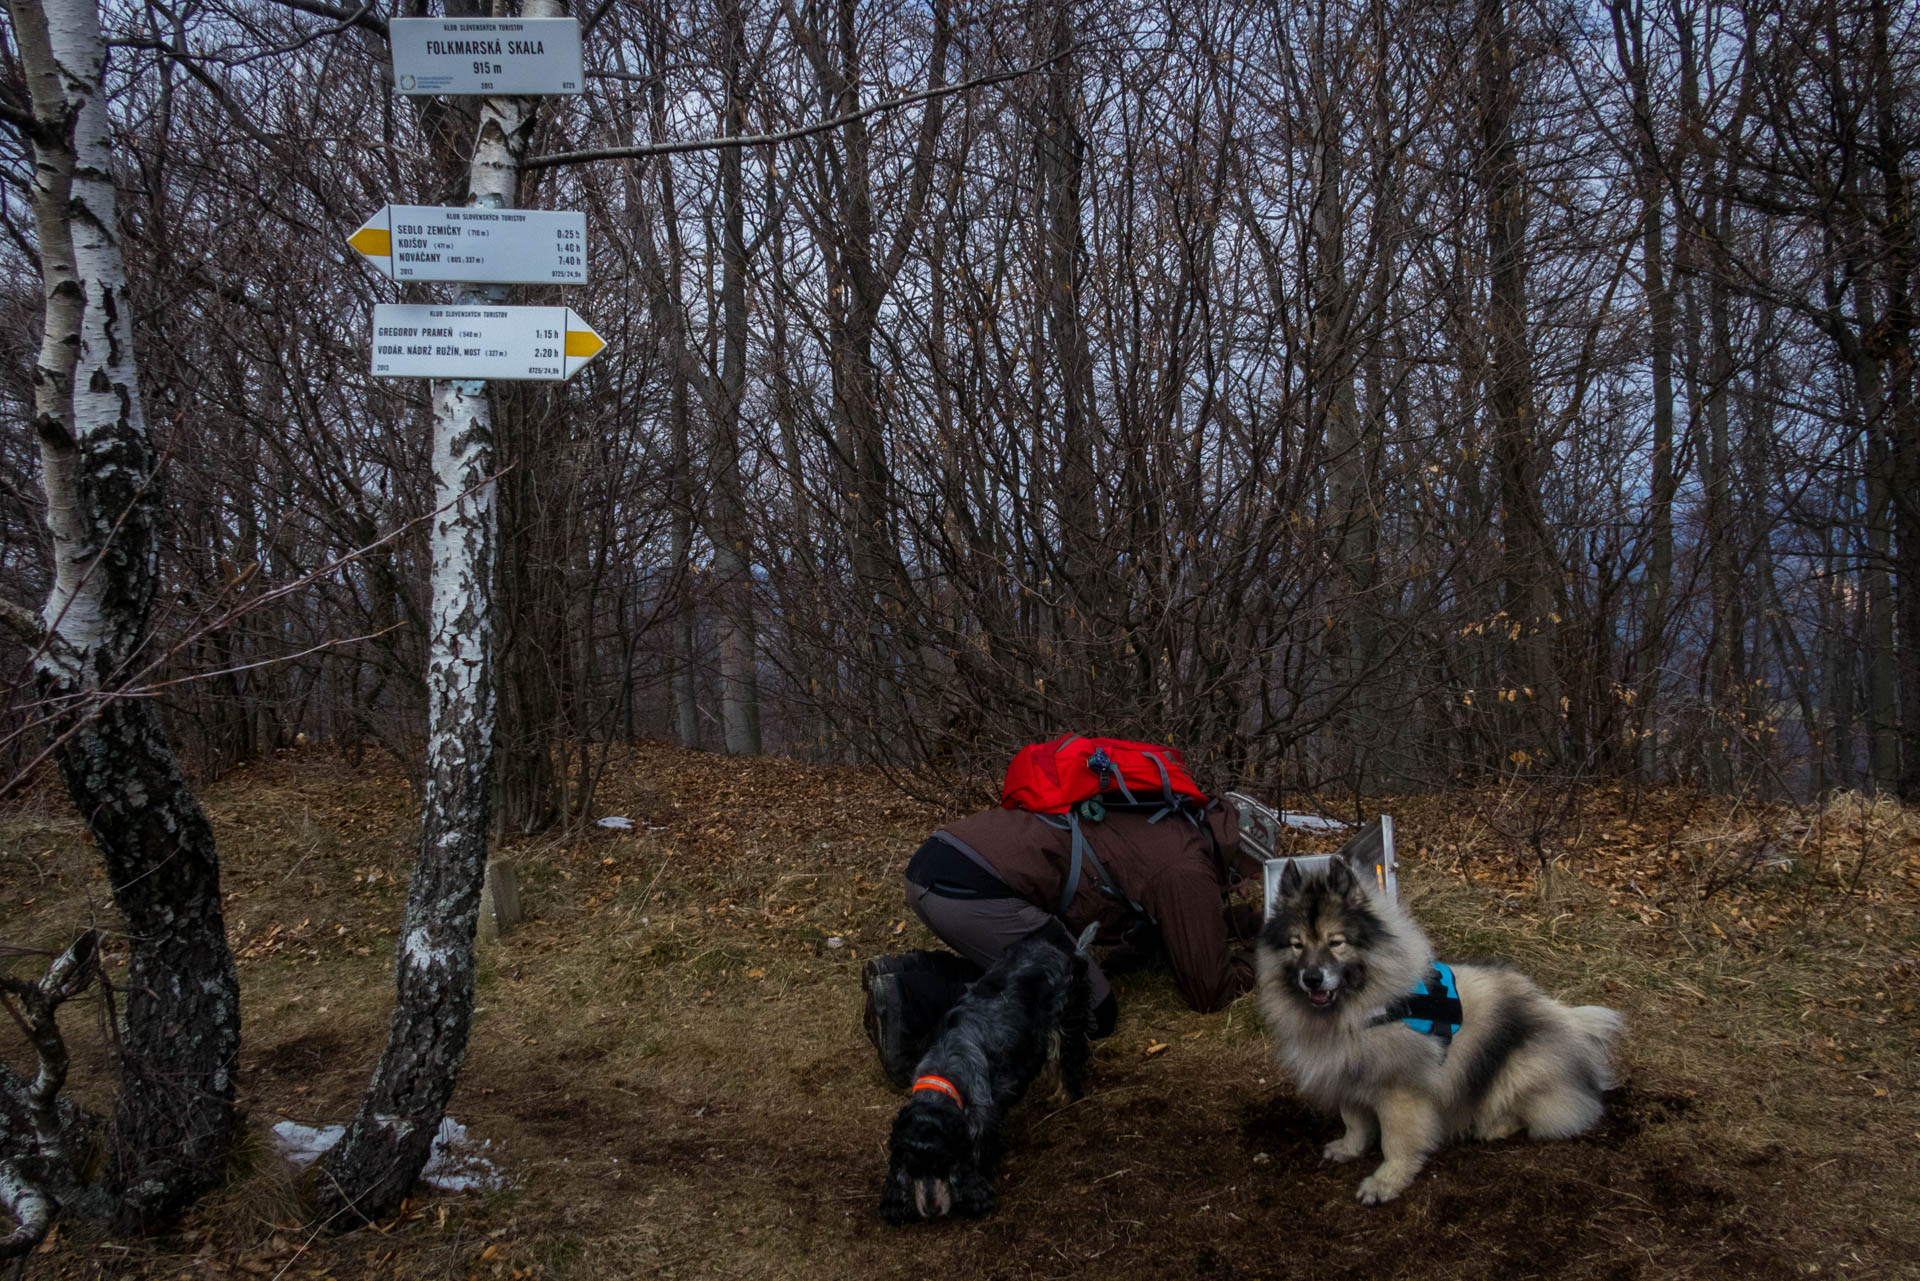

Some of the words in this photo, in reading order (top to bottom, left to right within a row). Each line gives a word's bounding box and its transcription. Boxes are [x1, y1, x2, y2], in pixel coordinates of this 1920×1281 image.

[498, 24, 524, 32] TURISTOV
[426, 38, 502, 54] FOLKMARSKÁ
[508, 40, 544, 54] SKALA
[473, 62, 490, 74] 915
[494, 64, 502, 74] m
[398, 224, 422, 234] SEDLO
[426, 224, 462, 236] ZEMIČKY
[556, 230, 574, 238] 0:25
[398, 238, 428, 248] KOJŠOV
[576, 244, 580, 252] h
[399, 252, 440, 262] NOVÁČANY
[558, 256, 574, 265] 7:40
[576, 256, 581, 265] h
[378, 328, 418, 336] GREGOROV
[422, 326, 453, 337] PRAMEŇ
[554, 330, 558, 338] h
[378, 344, 405, 354] VODÁR.
[407, 344, 432, 356] NÁDRŽ
[436, 344, 462, 356] RUŽÍN,
[534, 348, 552, 358] 2:20
[554, 348, 558, 358] h
